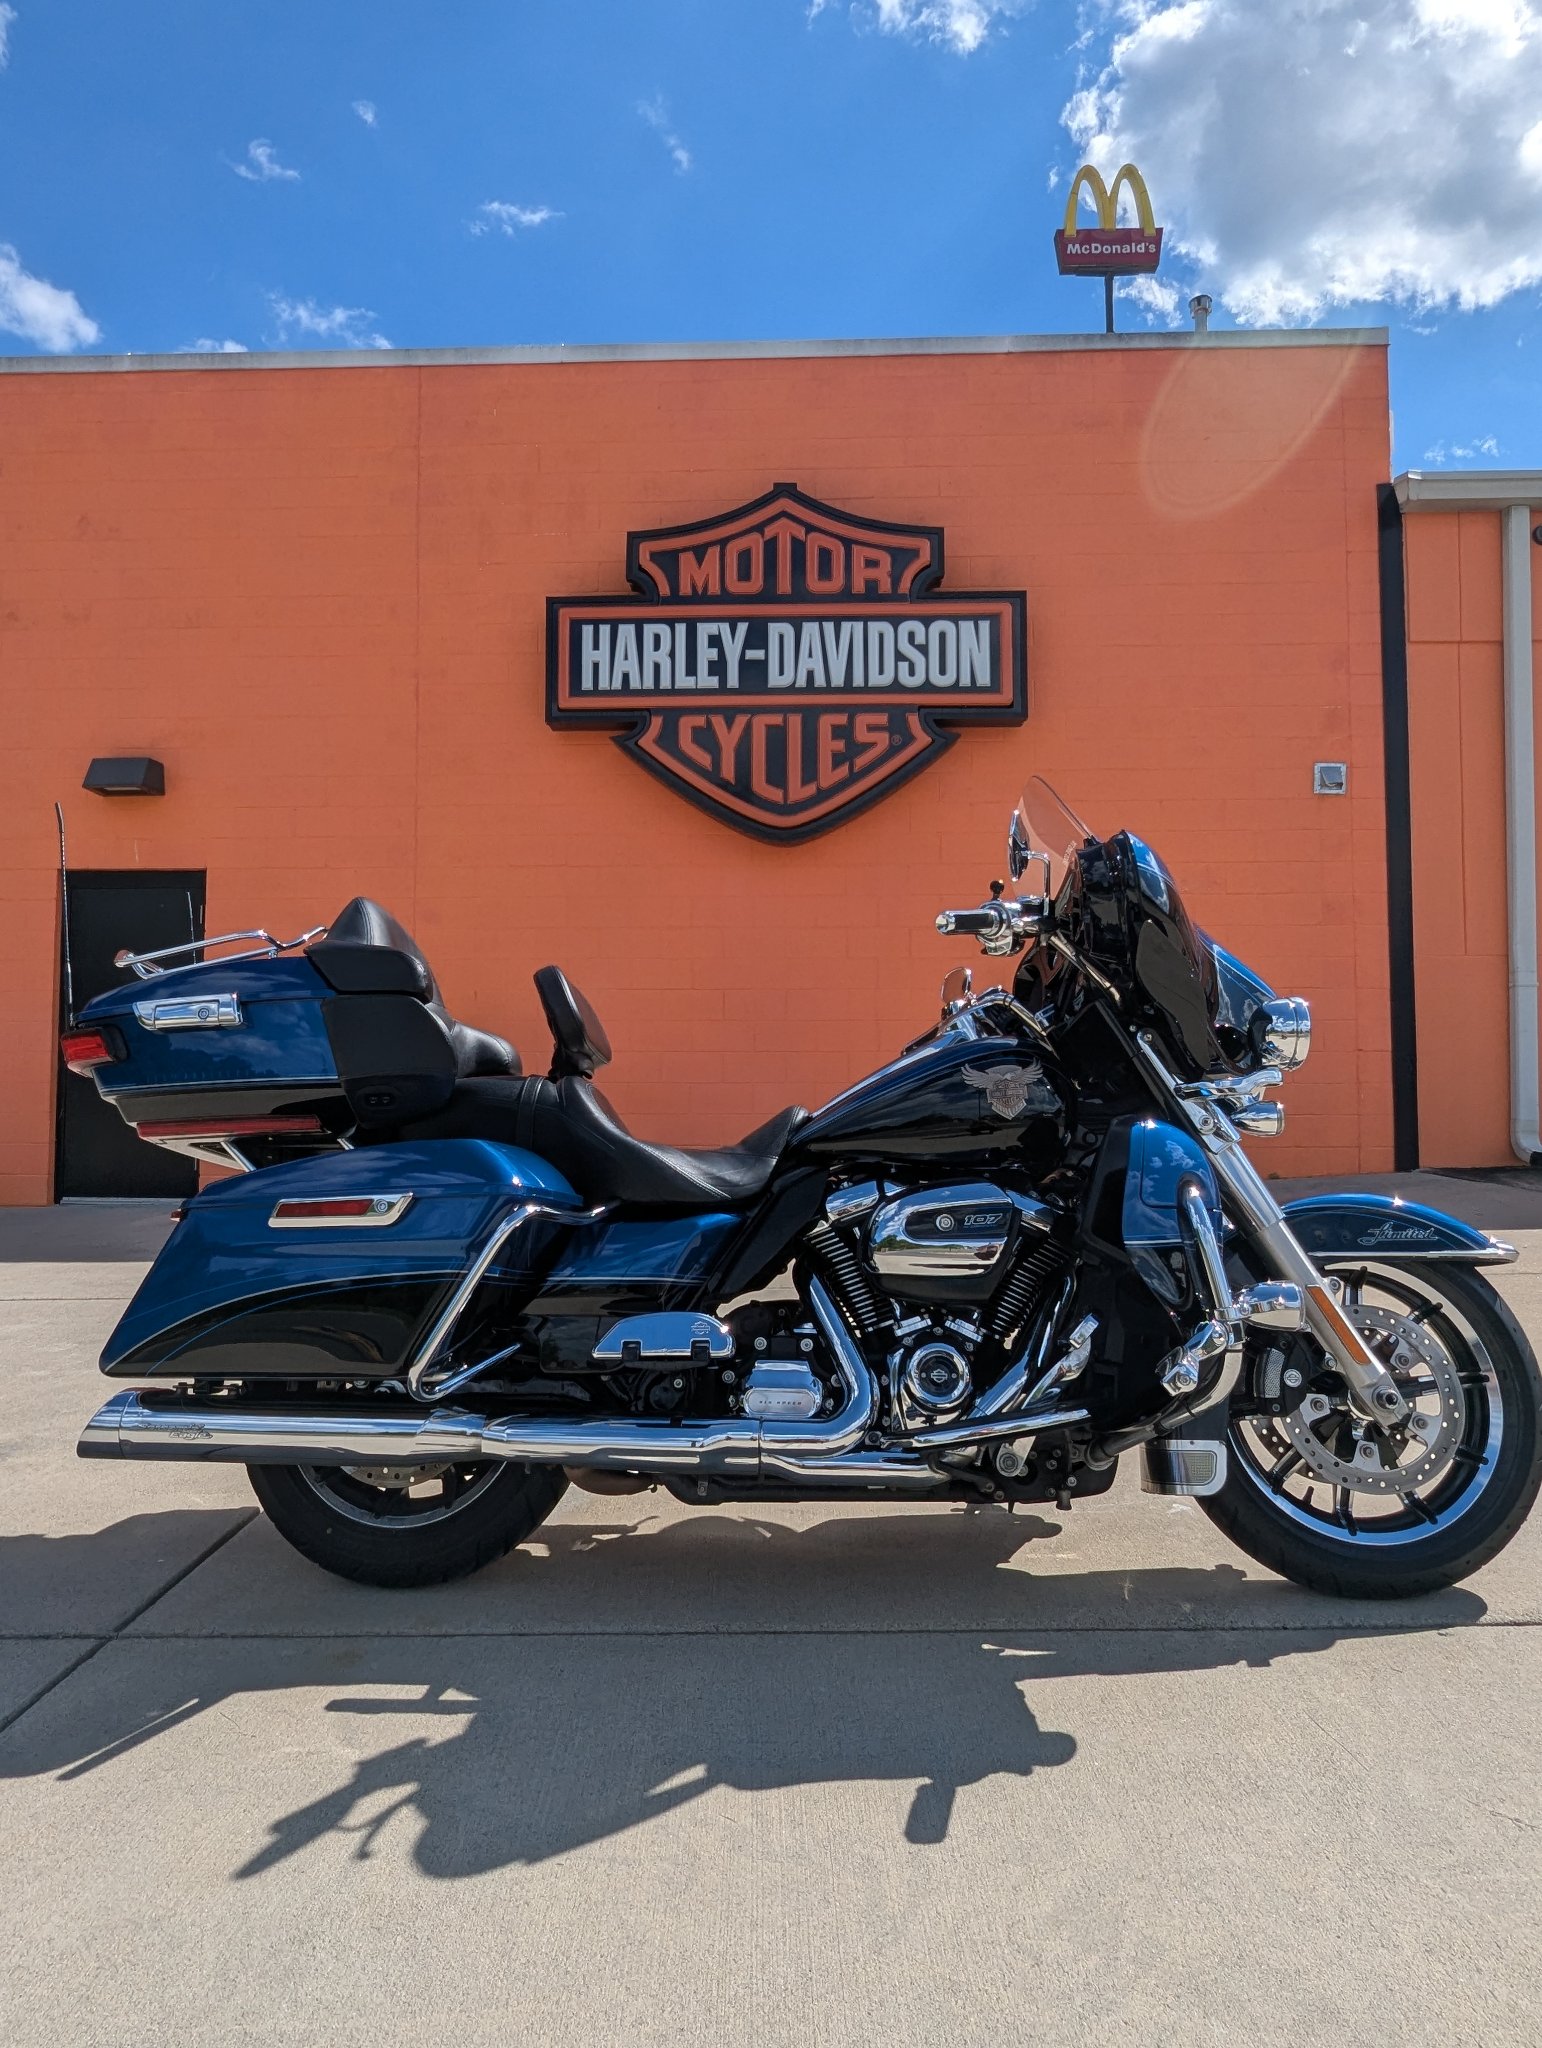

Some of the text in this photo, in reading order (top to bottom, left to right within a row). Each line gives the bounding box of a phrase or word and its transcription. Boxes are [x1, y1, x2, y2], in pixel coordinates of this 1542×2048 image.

[1066, 243, 1156, 255] McDonald's
[678, 517, 892, 596] MOTOR
[581, 620, 991, 690] HARLEY-DAVIDSON
[678, 713, 889, 804] CYCLES
